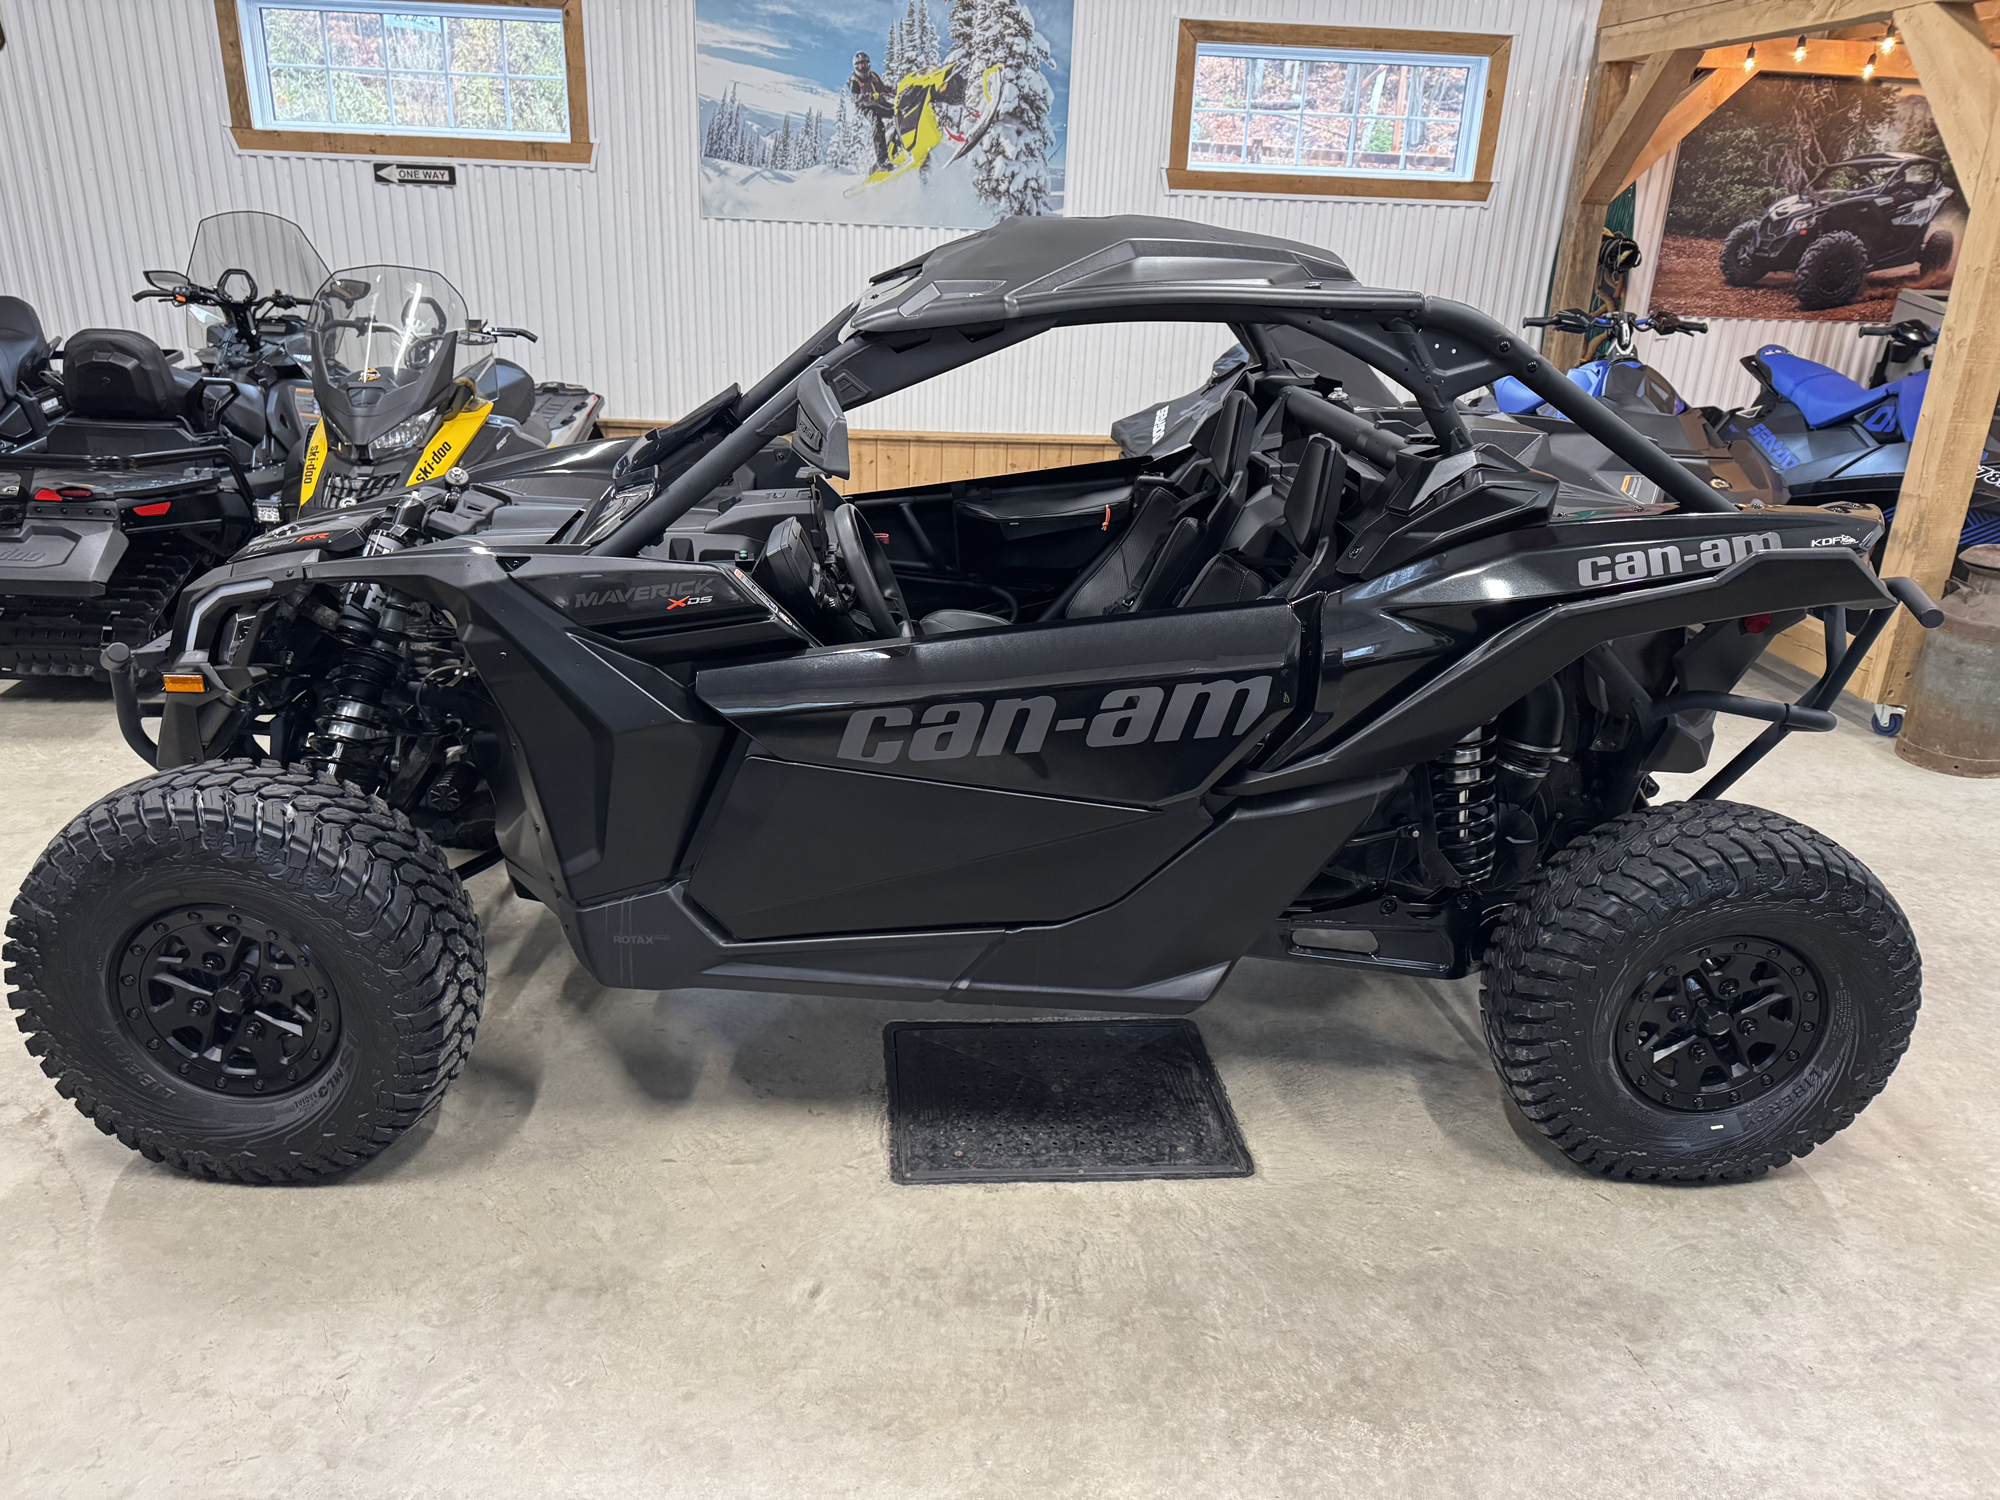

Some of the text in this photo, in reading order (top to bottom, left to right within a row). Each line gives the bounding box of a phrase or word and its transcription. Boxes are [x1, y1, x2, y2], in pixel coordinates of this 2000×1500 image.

[398, 169, 446, 180] ONE WAY
[303, 445, 319, 485] ski-doo
[415, 441, 452, 483] ski-doo
[1577, 531, 1783, 588] can-am
[574, 578, 715, 609] MAVERICK
[836, 675, 1274, 765] can-am
[612, 935, 654, 945] ROTAX
